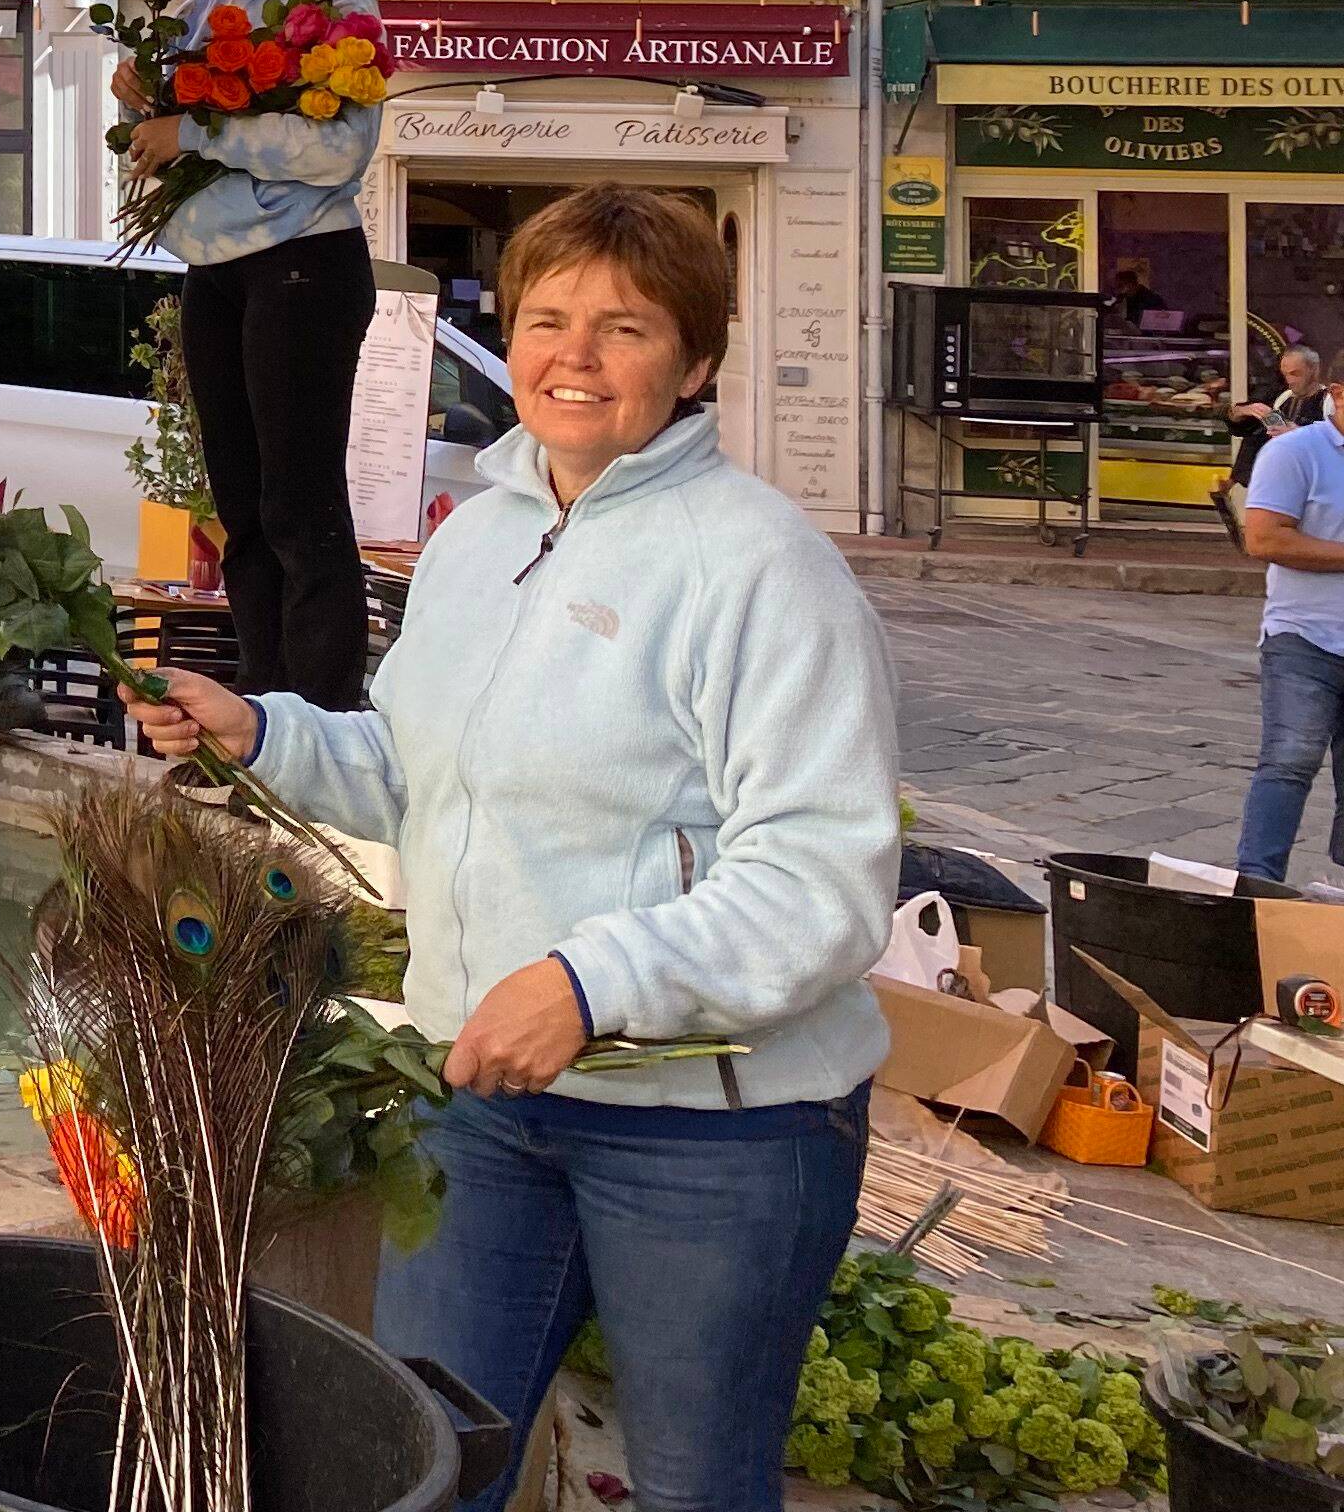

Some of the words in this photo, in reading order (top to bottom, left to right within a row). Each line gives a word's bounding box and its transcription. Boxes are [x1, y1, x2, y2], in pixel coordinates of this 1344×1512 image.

[393, 35, 608, 62] FABRICATION
[623, 38, 834, 65] ARTISANALE
[1049, 75, 1211, 96] BOUCHERIE
[1221, 76, 1274, 97] DES
[394, 110, 572, 148] Boulangerie
[614, 119, 770, 148] Pâtisserie
[1142, 116, 1185, 134] DES
[1104, 136, 1224, 162] OLIVIERS
